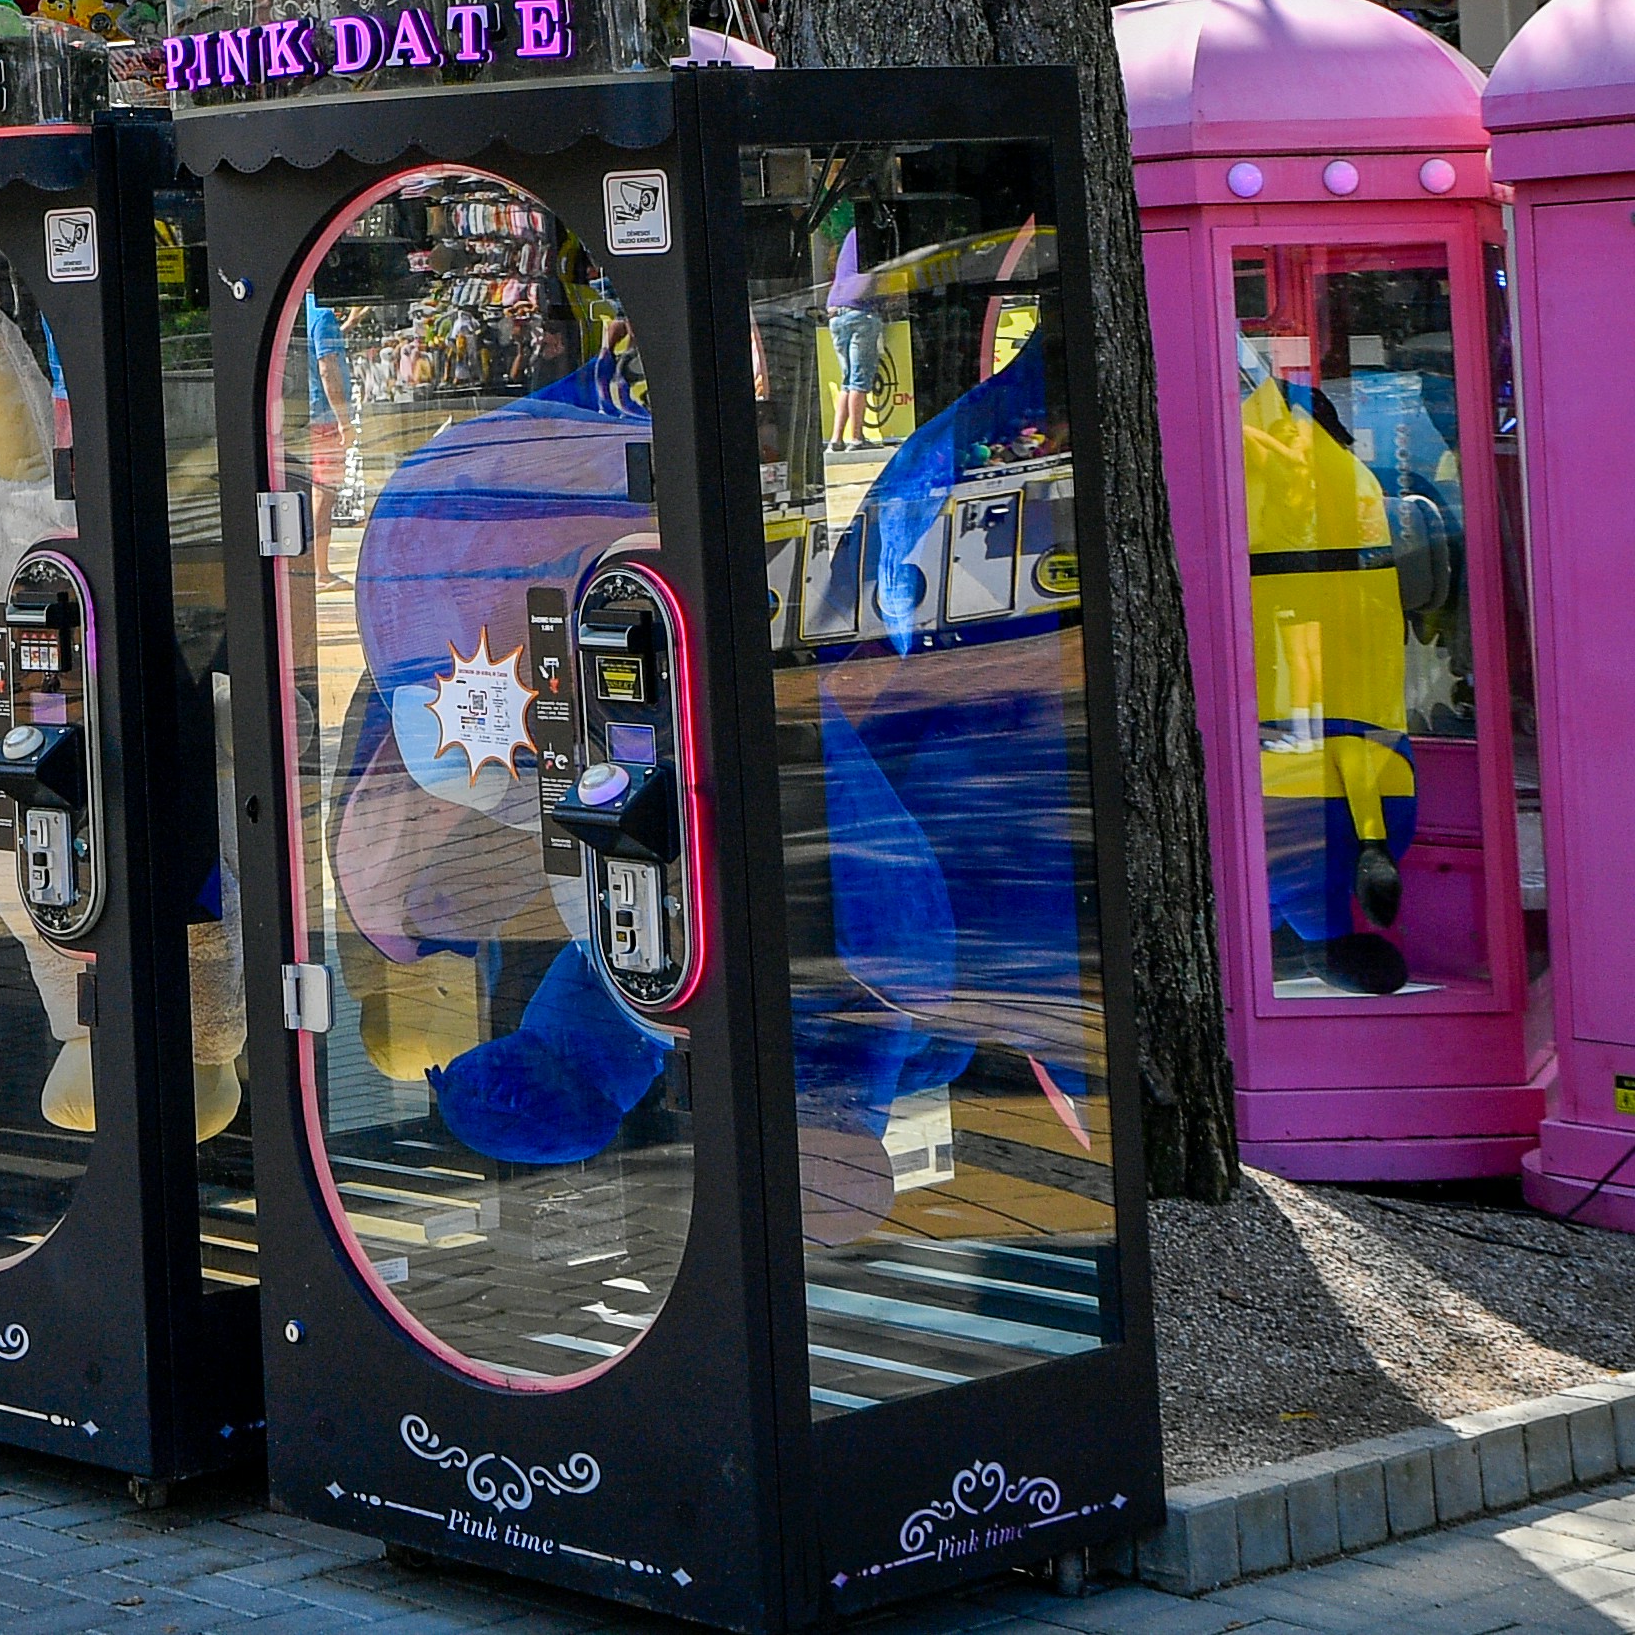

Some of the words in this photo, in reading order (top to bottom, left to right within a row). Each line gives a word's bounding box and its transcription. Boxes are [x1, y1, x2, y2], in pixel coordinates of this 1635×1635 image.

[163, 19, 317, 91] PINK
[447, 1508, 498, 1541] Pink
[504, 1524, 554, 1555] time
[937, 1529, 980, 1562] Pink
